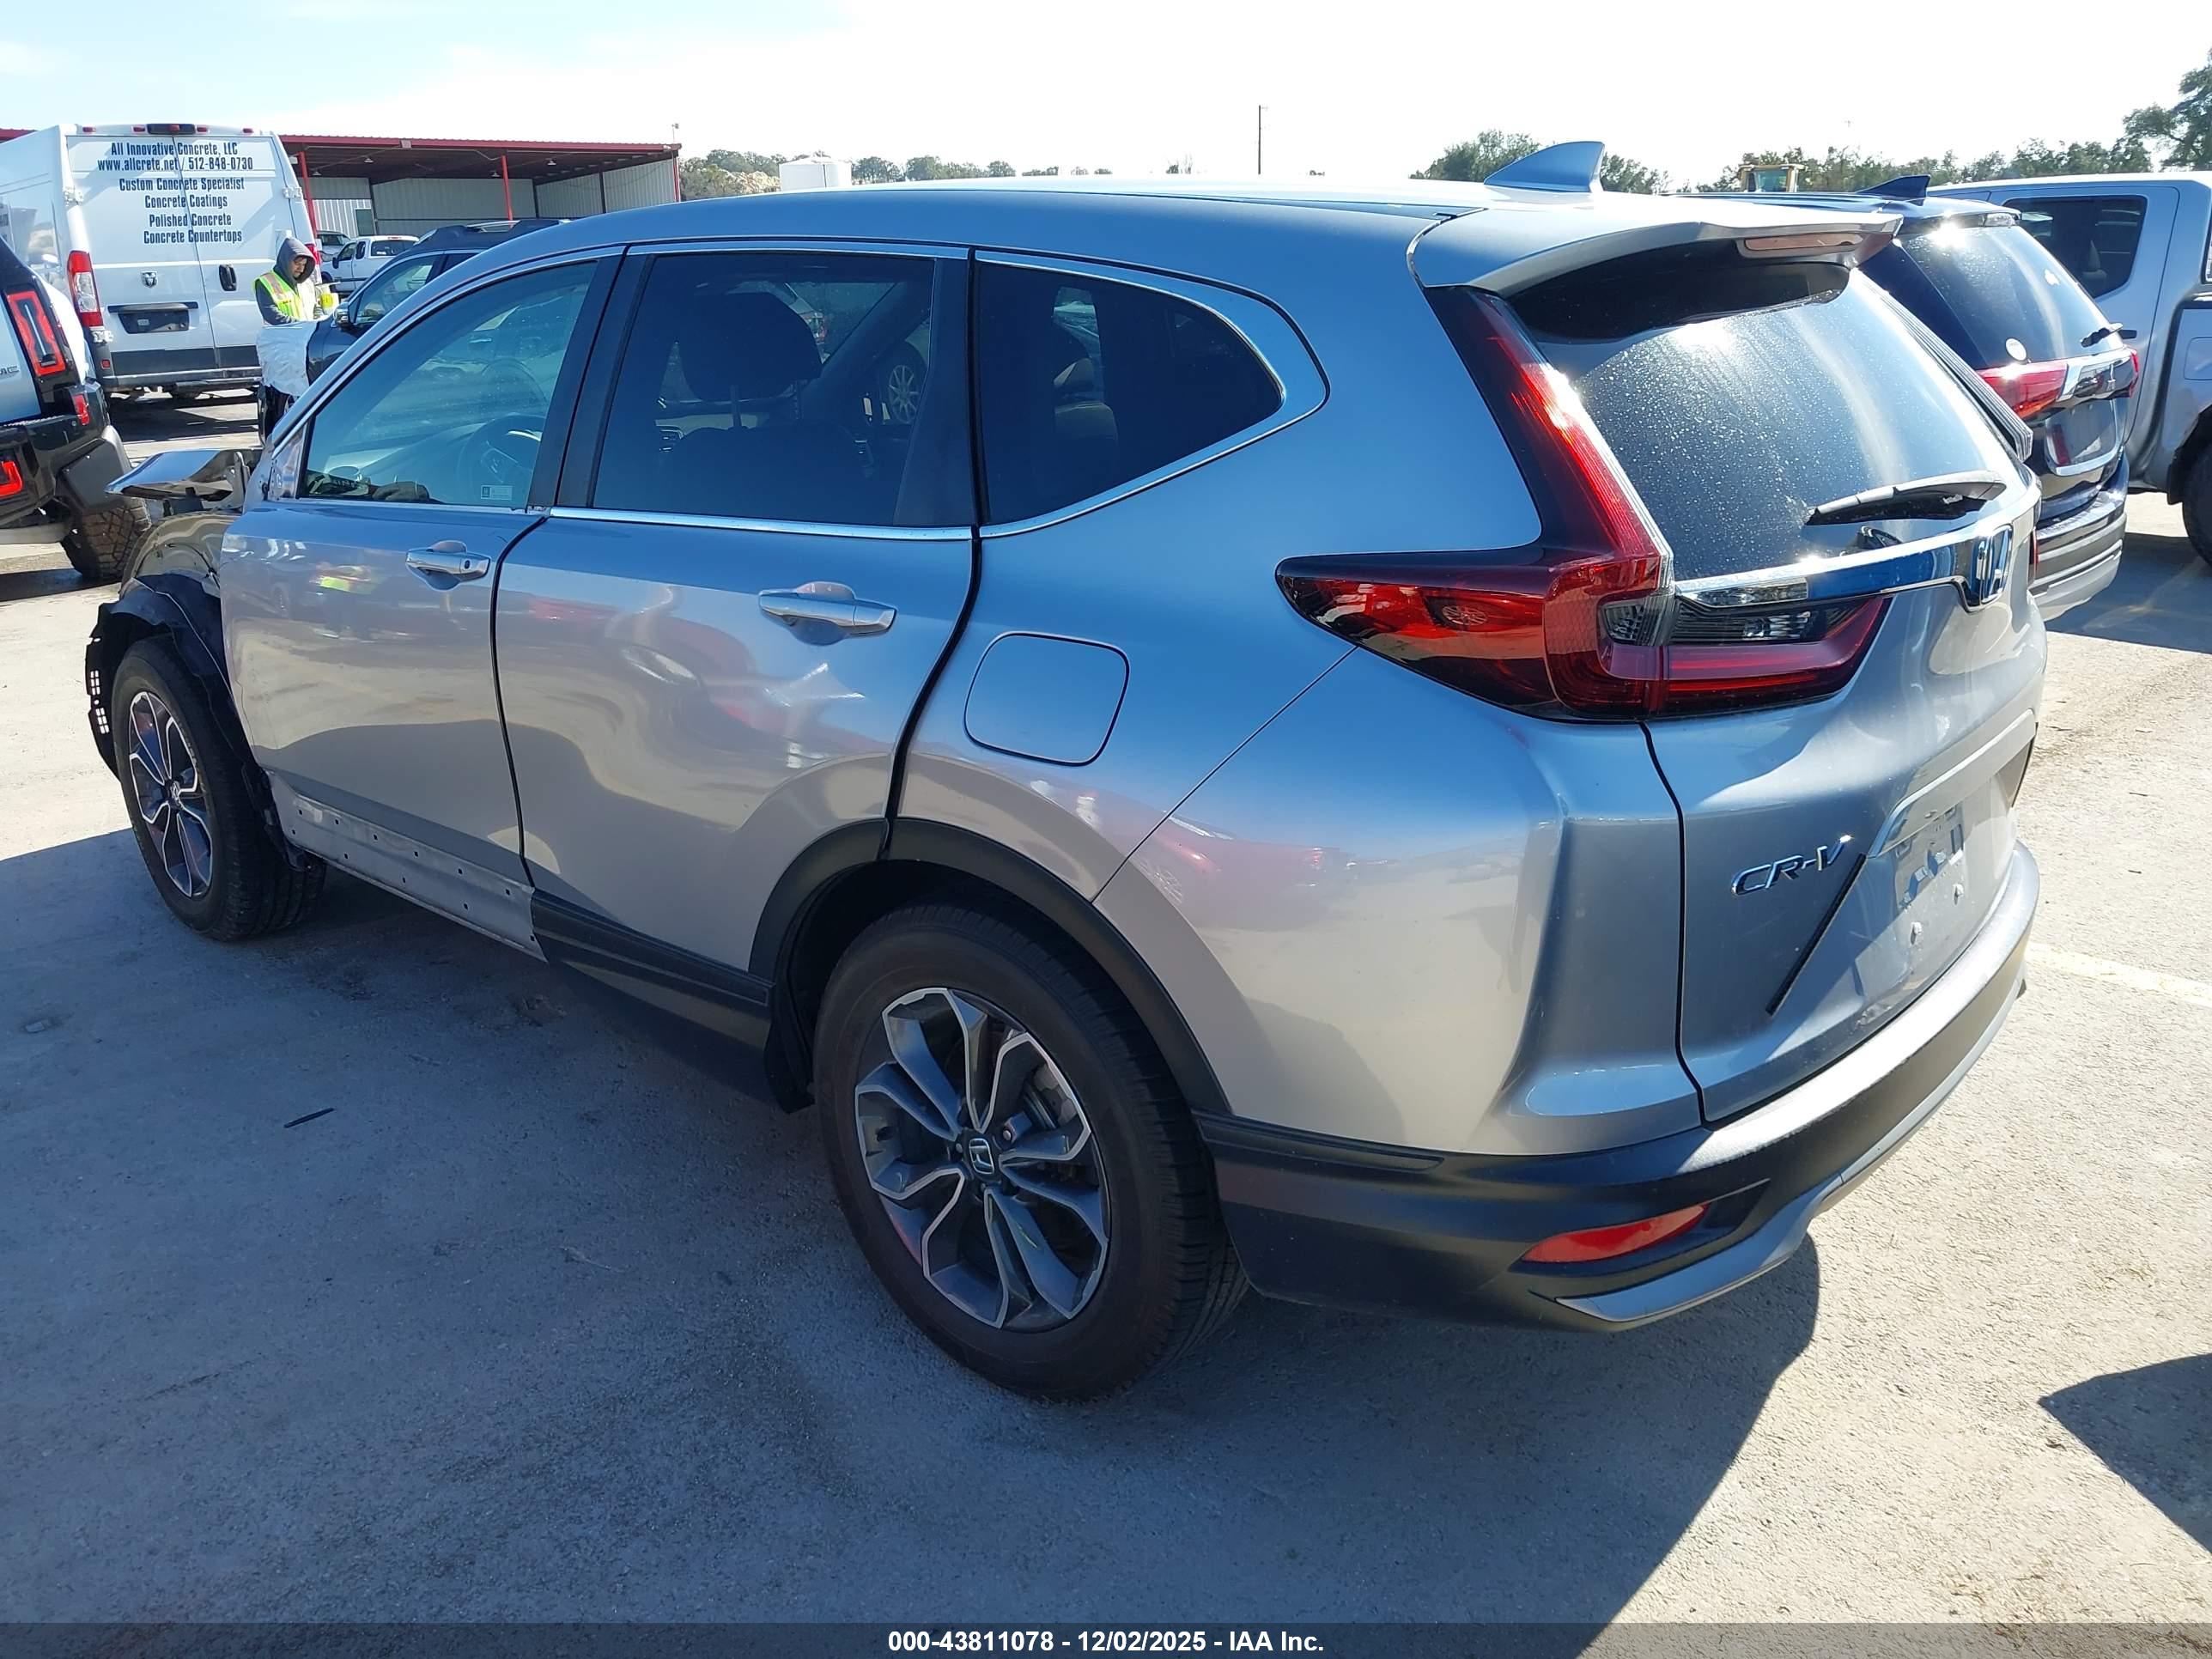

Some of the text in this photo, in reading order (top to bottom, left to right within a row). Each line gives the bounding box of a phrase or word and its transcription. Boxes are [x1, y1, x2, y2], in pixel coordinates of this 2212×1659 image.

[111, 142, 238, 156] All Innovative Concrete, LLC
[97, 157, 179, 171] www.allcrete.net
[188, 156, 253, 170] 512-848-0730
[119, 177, 245, 192] Custom Concrete Specialist
[144, 194, 228, 210] Concrete Coatings
[149, 214, 232, 228] Polished Concrete
[143, 229, 242, 244] Concrete Countertops
[1731, 835, 1852, 896] CR-V
